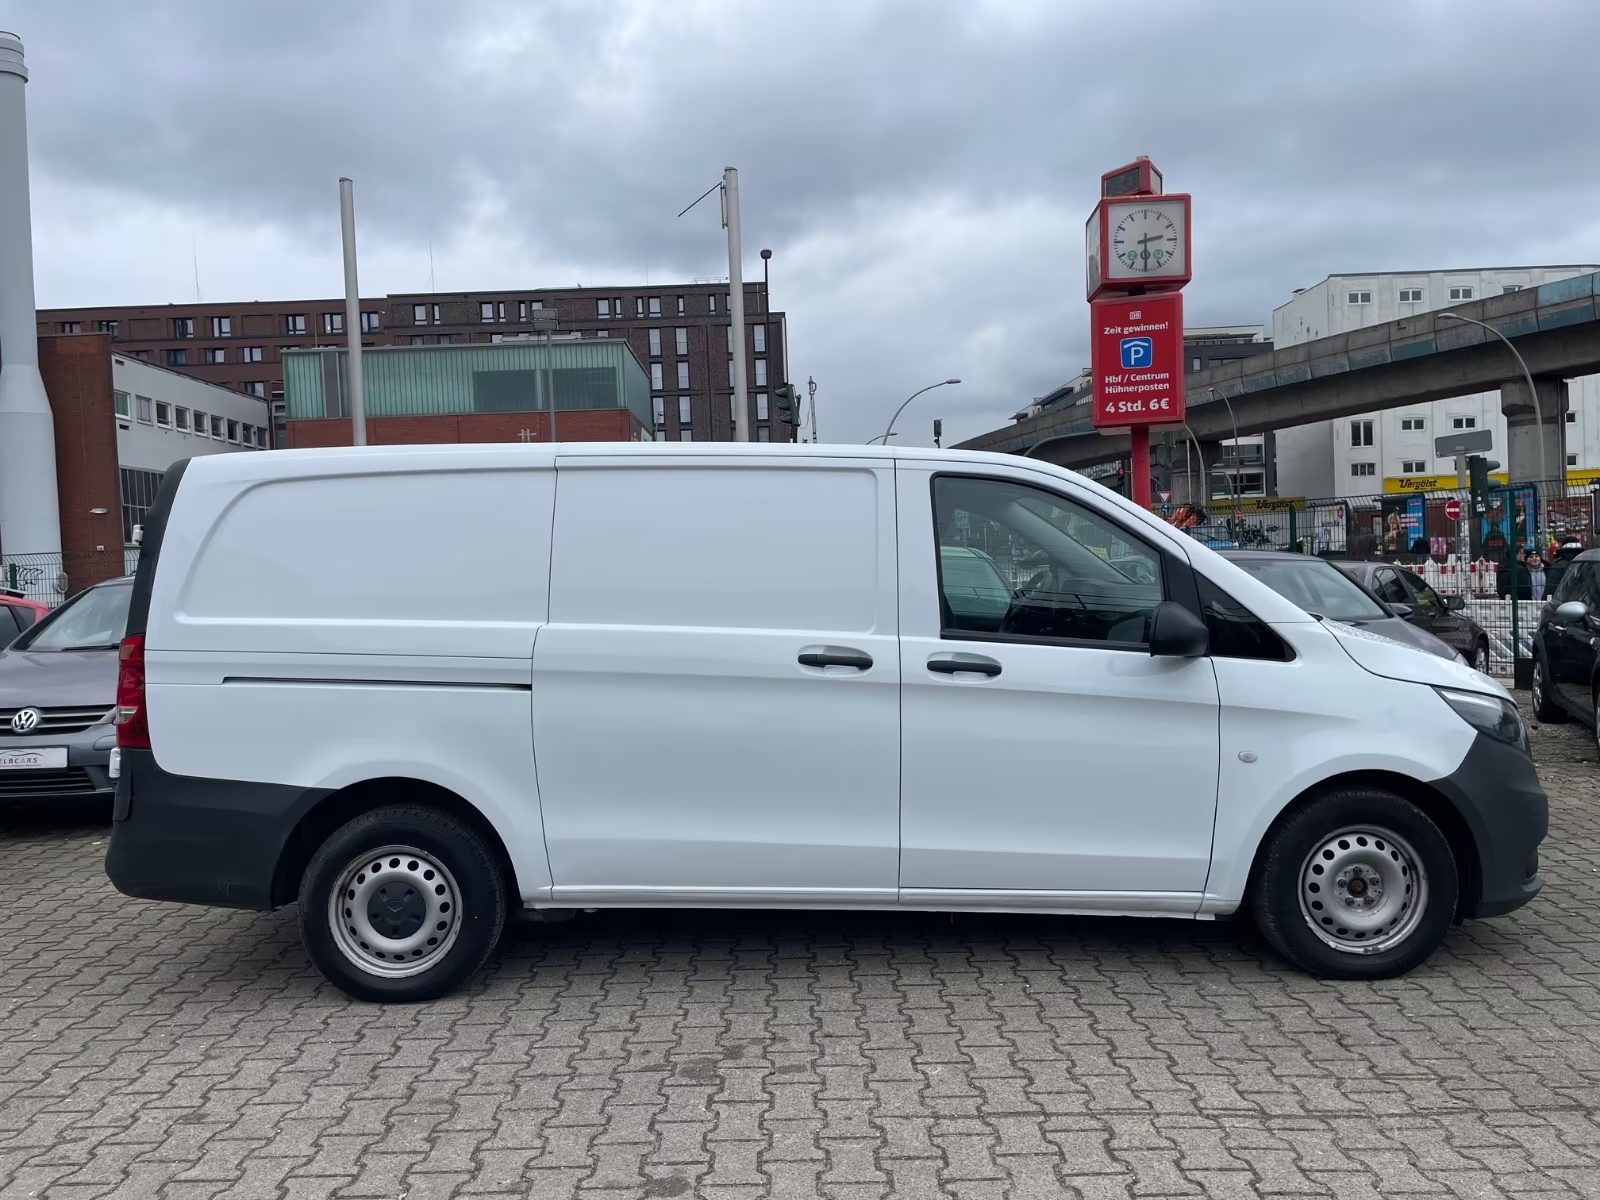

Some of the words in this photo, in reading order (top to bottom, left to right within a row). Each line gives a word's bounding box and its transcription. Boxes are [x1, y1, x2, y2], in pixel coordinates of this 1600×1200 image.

[1104, 326, 1122, 335] Zeit
[1123, 322, 1169, 335] gewinnen!
[1130, 347, 1144, 366] P
[1105, 374, 1122, 384] Hbf
[1130, 372, 1170, 382] Centrum
[1105, 382, 1170, 394] Hühnerposten
[1105, 402, 1116, 413] 4
[1118, 400, 1146, 413] Std.
[1399, 479, 1438, 490] Vergölst
